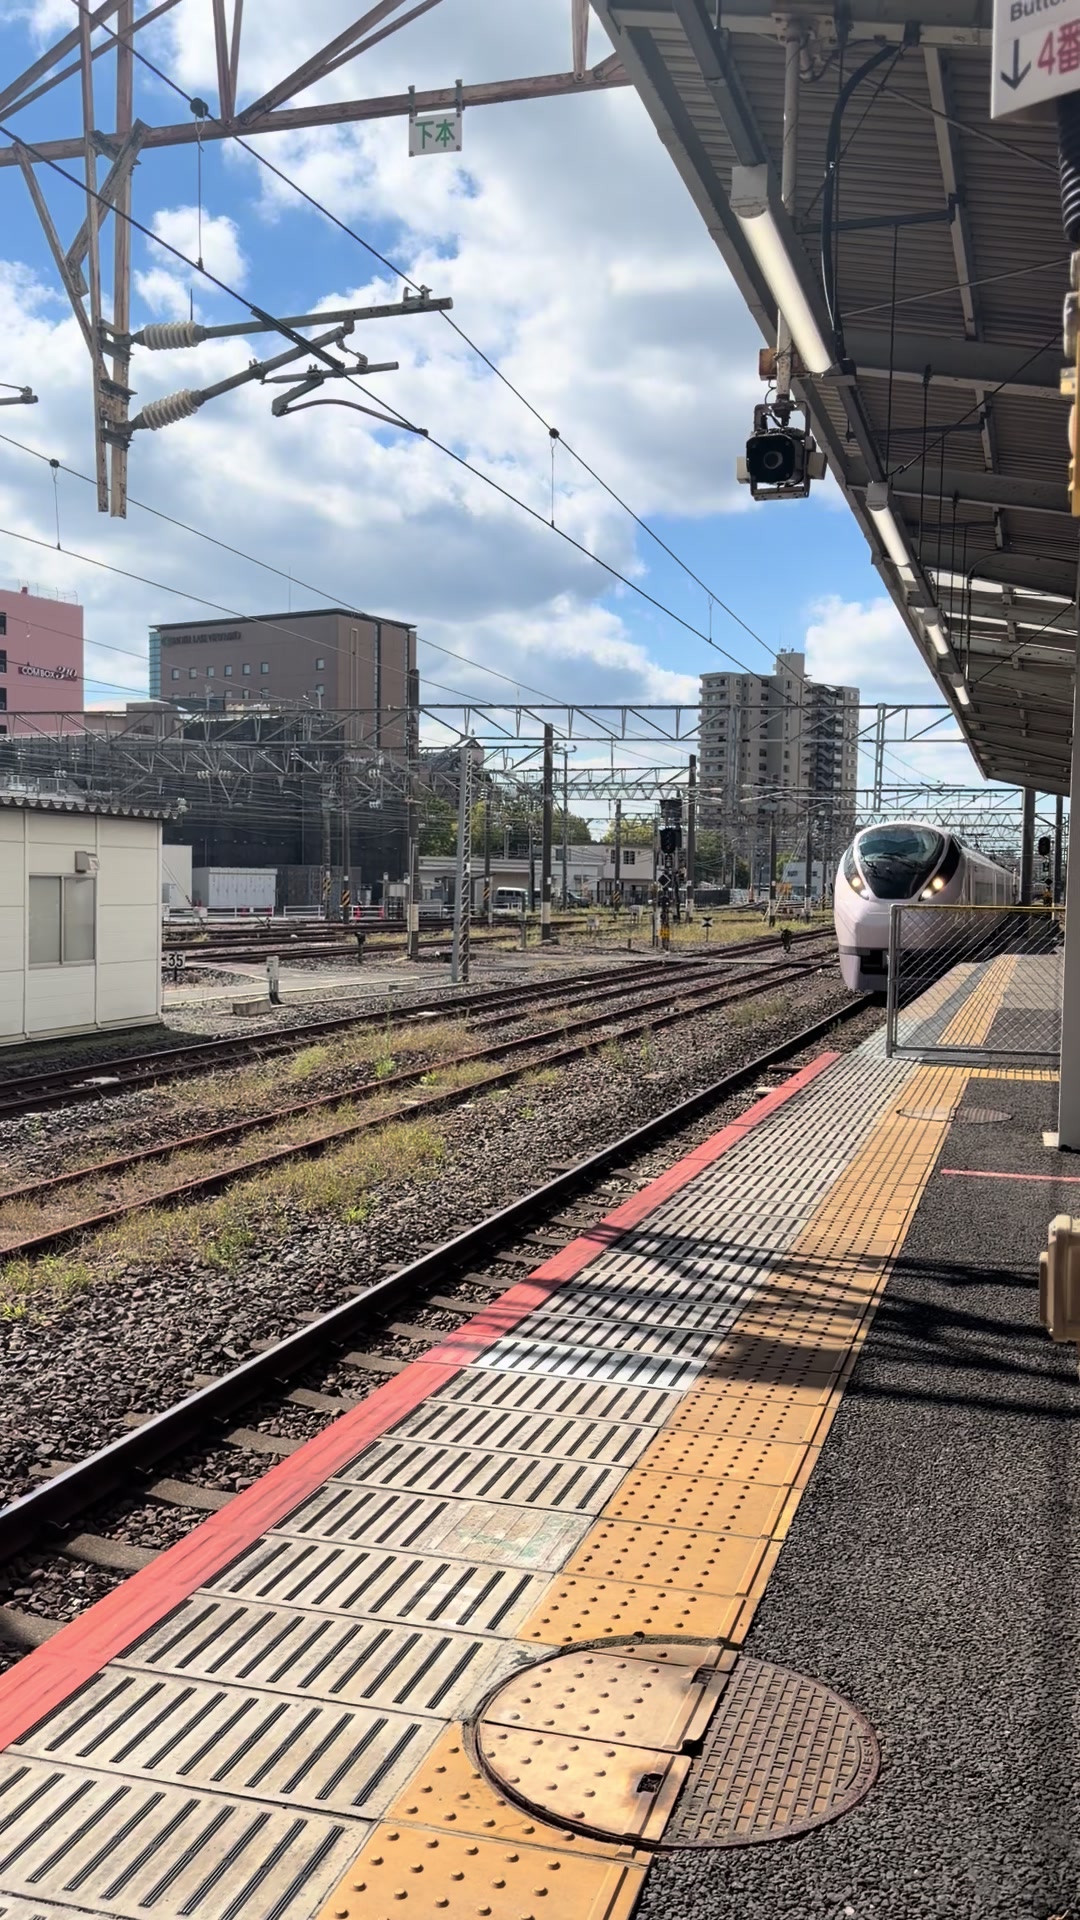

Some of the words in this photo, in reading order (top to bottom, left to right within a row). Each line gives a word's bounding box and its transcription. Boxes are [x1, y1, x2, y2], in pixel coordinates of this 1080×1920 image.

[415, 118, 455, 150] 下本
[56, 665, 78, 680] 310
[168, 953, 184, 968] 35
